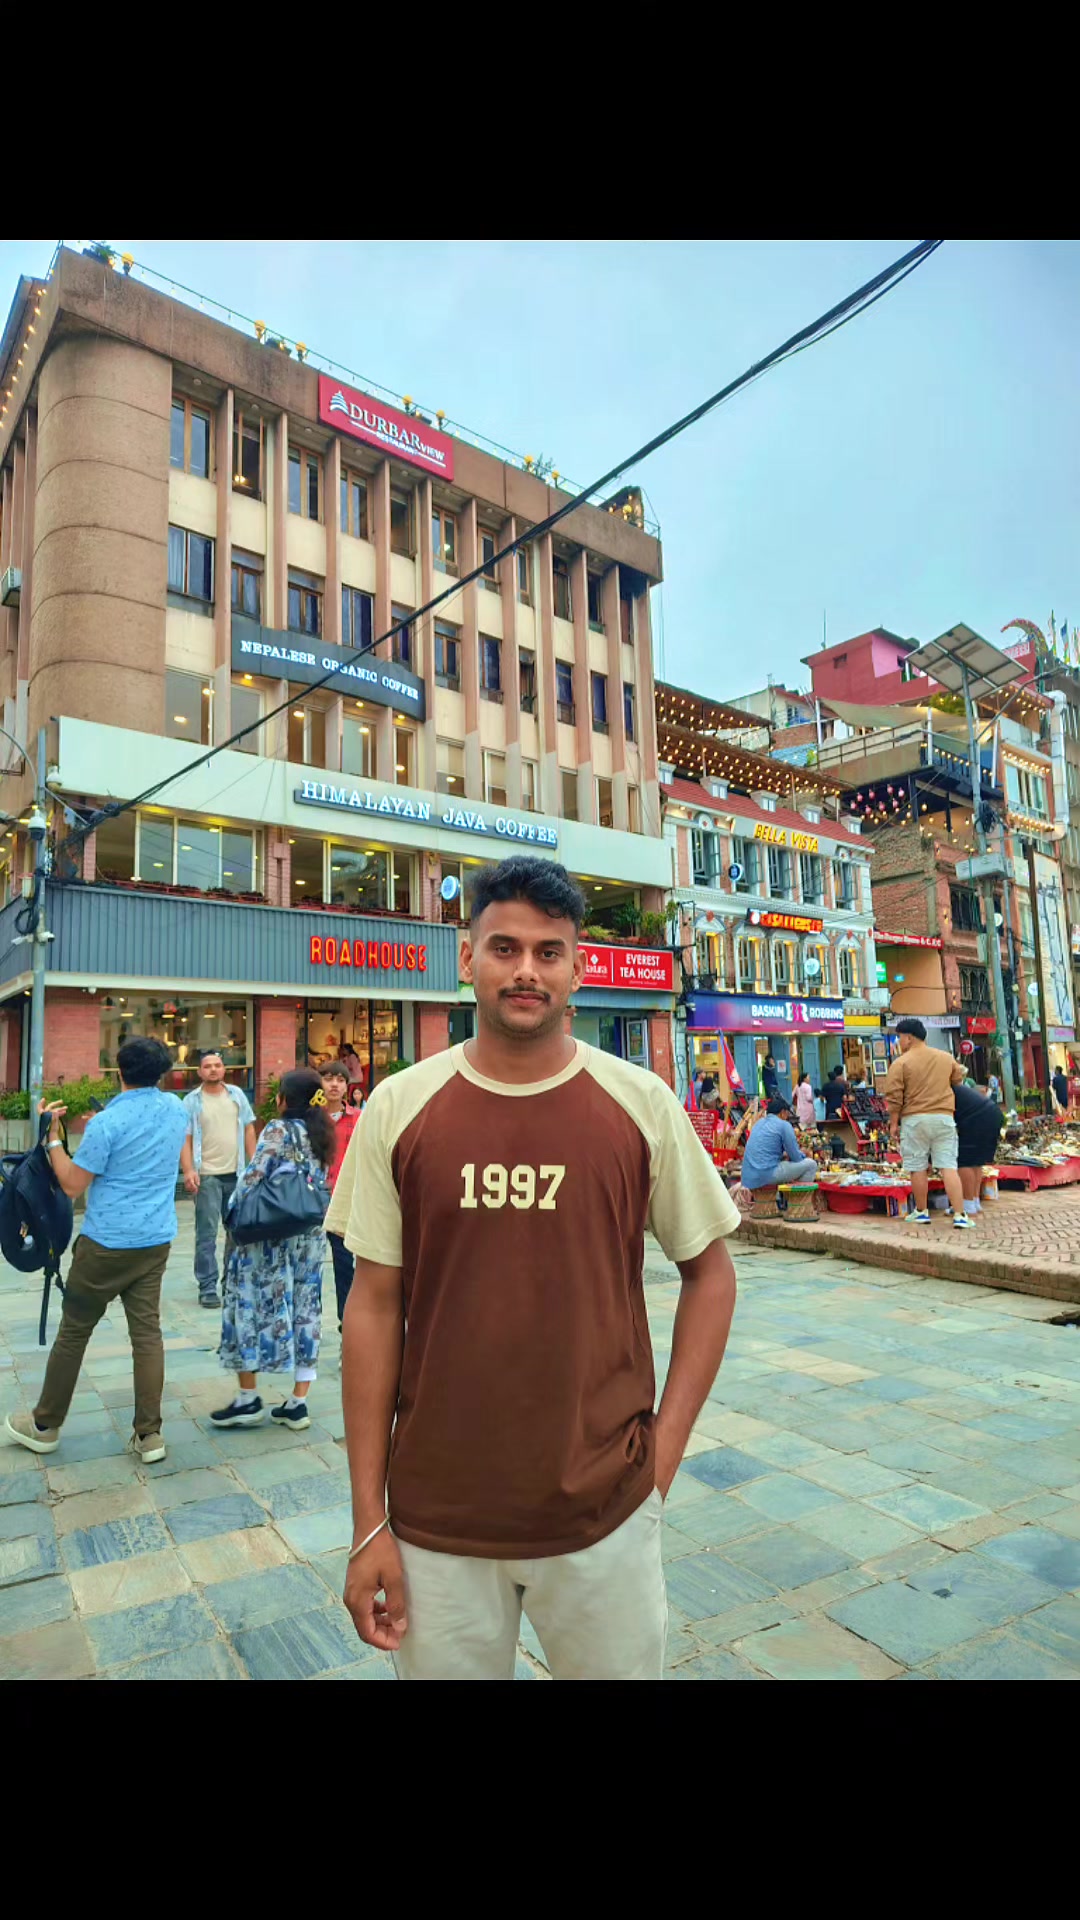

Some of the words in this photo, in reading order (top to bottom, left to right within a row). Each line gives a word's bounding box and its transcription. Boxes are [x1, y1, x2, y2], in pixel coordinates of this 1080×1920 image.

[349, 402, 421, 449] DURBAR
[240, 640, 316, 666] NEPALESE
[381, 675, 419, 700] COFFEE
[300, 779, 431, 820] HIMALAYAN
[442, 807, 487, 831] JAVA
[495, 817, 558, 844] COFFEE
[754, 823, 787, 845] BELLA
[791, 832, 819, 853] VISTA
[310, 935, 427, 972] ROADHOUSE
[625, 953, 660, 967] EVEREST
[619, 966, 635, 979] TEA
[637, 968, 666, 981] HOUSE
[751, 1004, 784, 1018] BASKIN
[809, 1007, 844, 1020] ROBBINS
[460, 1163, 566, 1210] 1997
